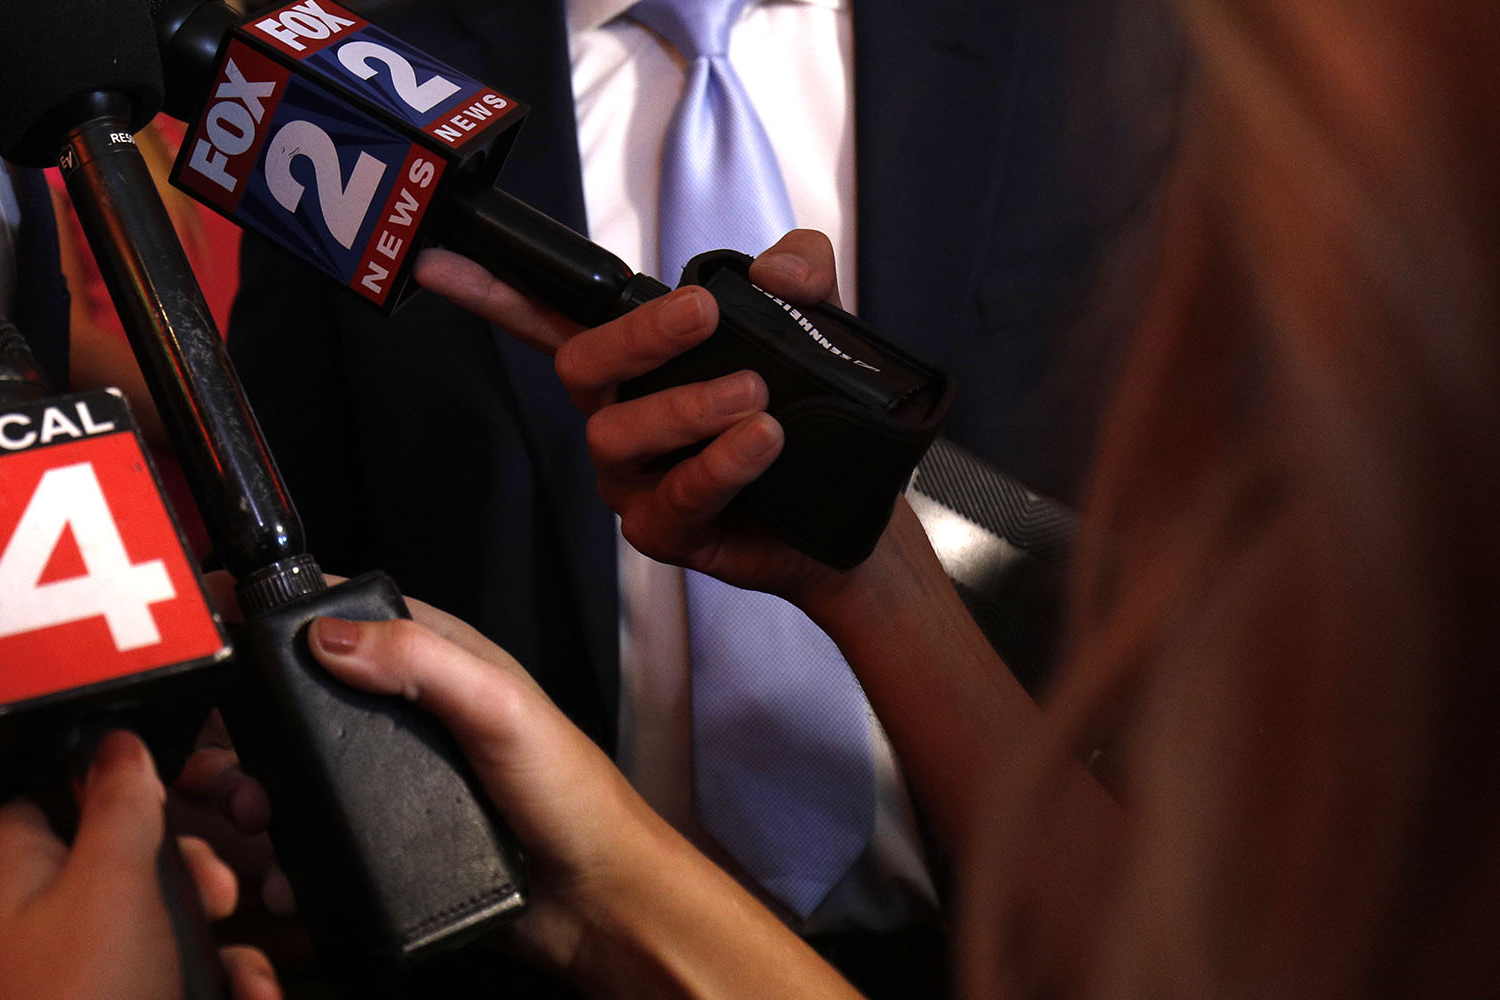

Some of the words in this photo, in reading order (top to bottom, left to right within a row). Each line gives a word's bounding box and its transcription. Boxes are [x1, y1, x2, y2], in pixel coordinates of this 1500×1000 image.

[188, 57, 277, 193] FOX
[337, 40, 461, 114] 2
[433, 93, 508, 143] NEWS
[264, 119, 388, 251] 2
[360, 157, 436, 295] NEWS
